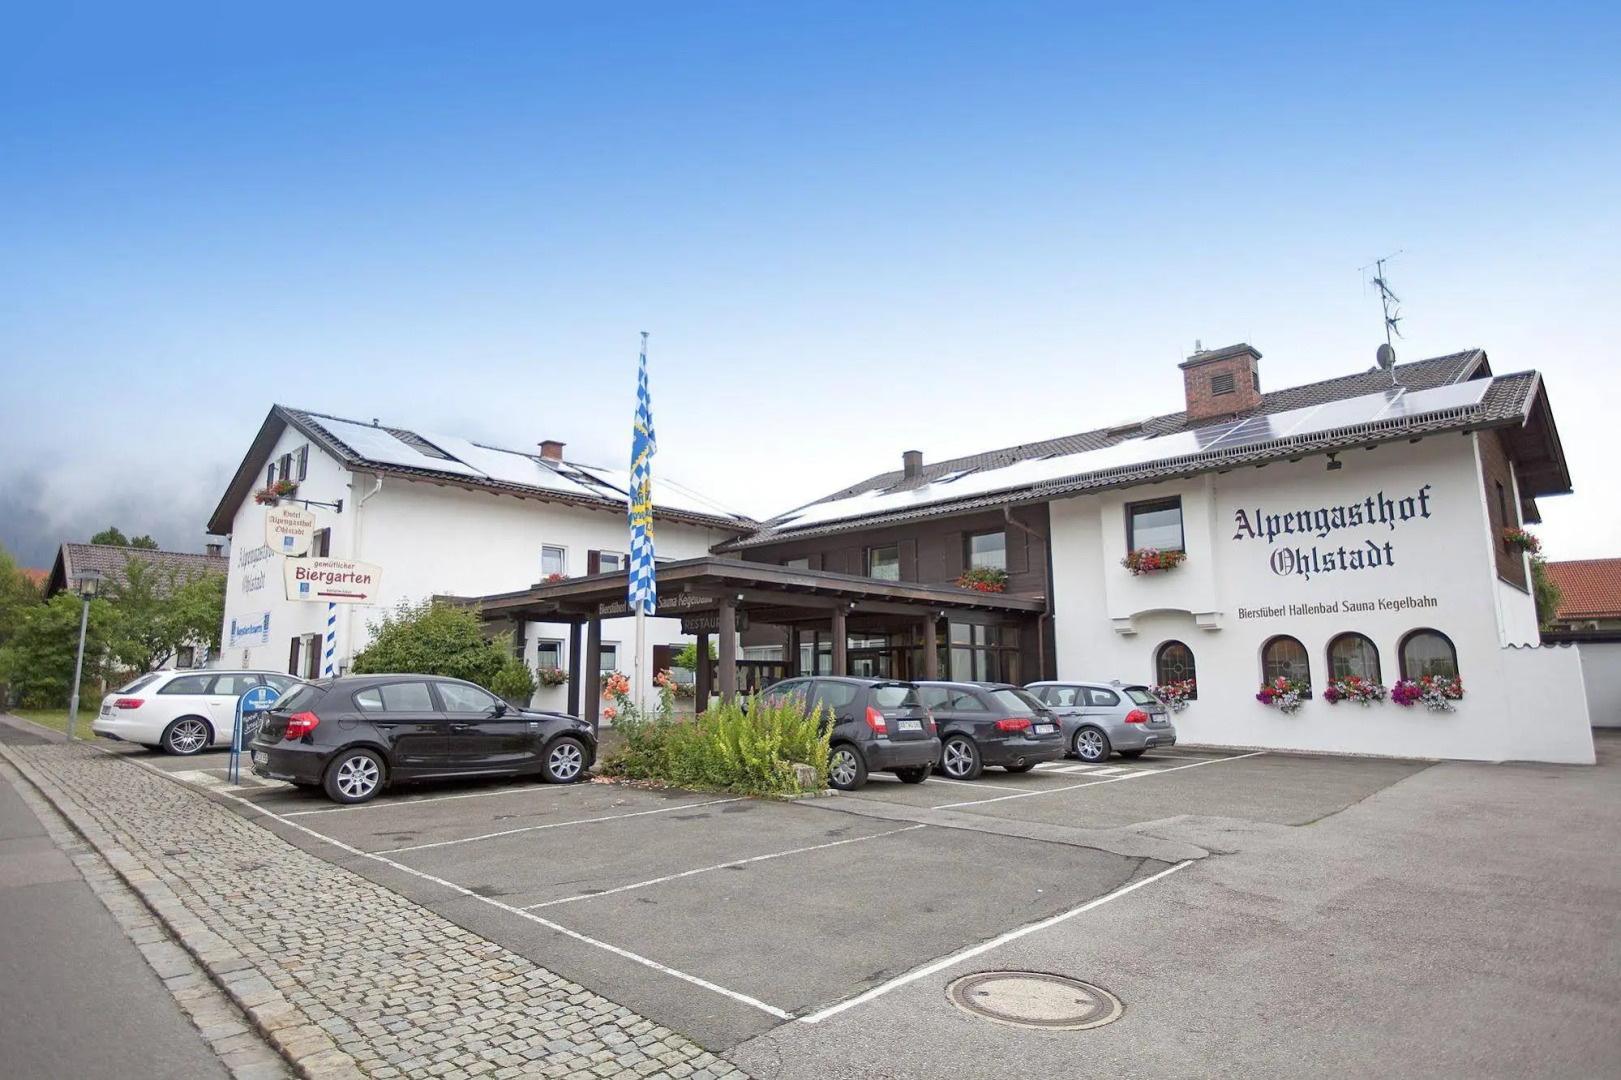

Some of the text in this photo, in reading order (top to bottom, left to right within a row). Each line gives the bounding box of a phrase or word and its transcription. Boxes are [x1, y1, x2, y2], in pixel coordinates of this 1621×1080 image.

[283, 510, 301, 518] Hotel
[1232, 484, 1432, 544] Alpengasthof
[269, 516, 312, 528] Alpengasthof
[314, 561, 356, 570] gemütlicher
[1270, 539, 1395, 581] Ohlstadt
[295, 567, 371, 585] Biergarten
[658, 596, 677, 608] Sauna
[1238, 595, 1438, 619] Bierstüberl Hallenbad Sauna Kegelbahn
